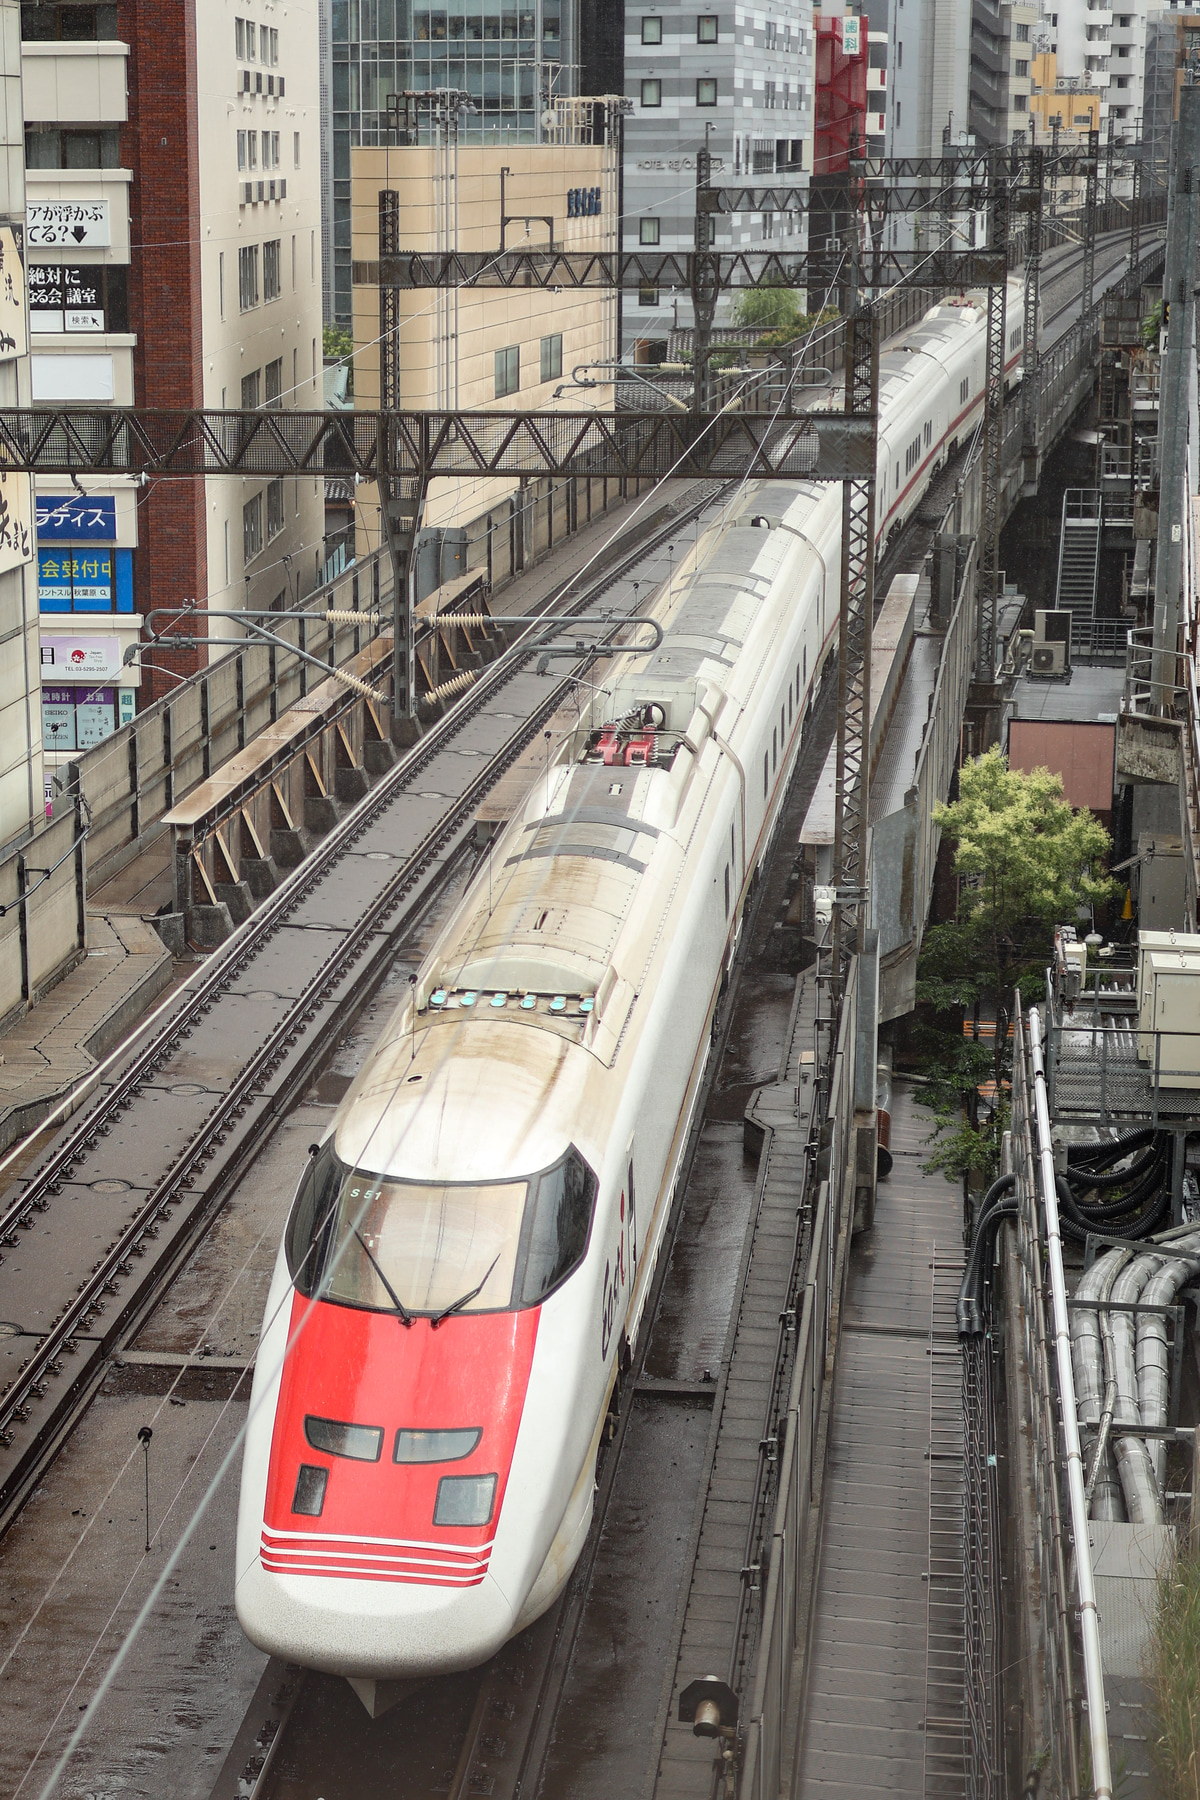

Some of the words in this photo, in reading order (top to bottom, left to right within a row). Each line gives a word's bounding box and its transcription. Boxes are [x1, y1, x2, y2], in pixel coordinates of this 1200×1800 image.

[28, 205, 104, 222] アが浮かぶ
[29, 267, 81, 285] 絶対に
[71, 315, 90, 325] 検索
[36, 508, 106, 527] ラティス
[38, 559, 111, 578] 会受付中
